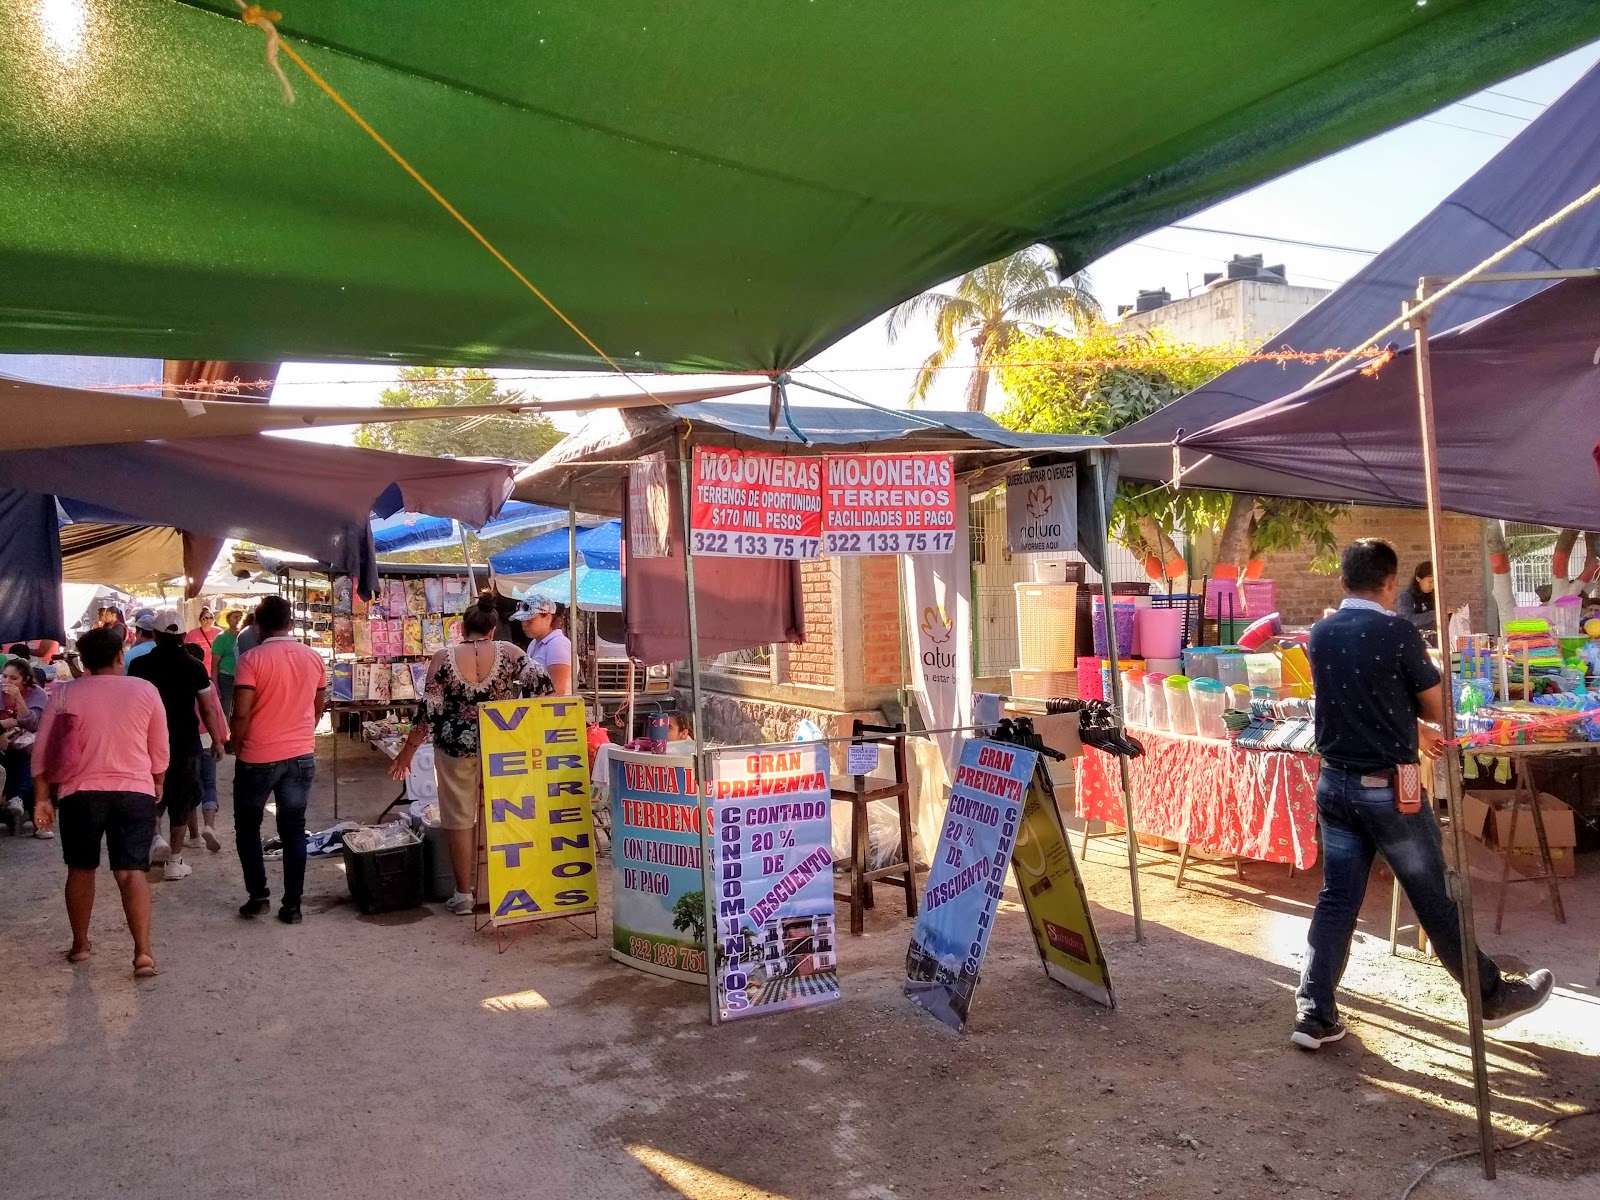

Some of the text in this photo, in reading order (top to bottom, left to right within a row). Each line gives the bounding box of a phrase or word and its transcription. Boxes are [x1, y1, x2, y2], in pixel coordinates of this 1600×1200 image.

[700, 452, 821, 491] MOJONERAS
[828, 459, 951, 487] MOJONERAS
[1047, 469, 1052, 481] O
[1053, 466, 1074, 480] VENDER
[697, 485, 822, 513] TERRENOS DE OPORTUNIDAD
[828, 489, 950, 507] TERRENOS
[712, 508, 802, 531] $170 MIL PESOS
[828, 510, 954, 527] FACILIDADES DE PAGO
[1020, 520, 1061, 540] natura
[694, 532, 818, 558] 322 133 75 17
[827, 532, 954, 552] 322 133 75 17
[932, 674, 950, 684] estar
[532, 748, 542, 770] DE
[746, 751, 804, 775] GRAN
[978, 746, 1014, 772] GRAN
[624, 762, 680, 795] VENTA
[716, 771, 827, 801] PREVENTA
[955, 766, 1025, 803] PREVENTA
[483, 706, 542, 917] VENTA
[540, 702, 592, 906] TERRENOS
[744, 800, 827, 827] CONTADO
[948, 793, 1000, 827] CONTADO
[750, 831, 795, 852] 20 %
[946, 822, 976, 845] 20 %
[623, 838, 644, 862] CON
[944, 848, 962, 869] DE
[762, 854, 784, 875] DE
[624, 868, 670, 897] DE PAGO
[748, 846, 833, 929] DESCUENTO
[926, 854, 992, 912] DESCUENTO
[964, 806, 1018, 976] CONDOMINIOS
[720, 806, 750, 1012] CONDOMINIOS
[629, 936, 708, 972] 322 133 751
